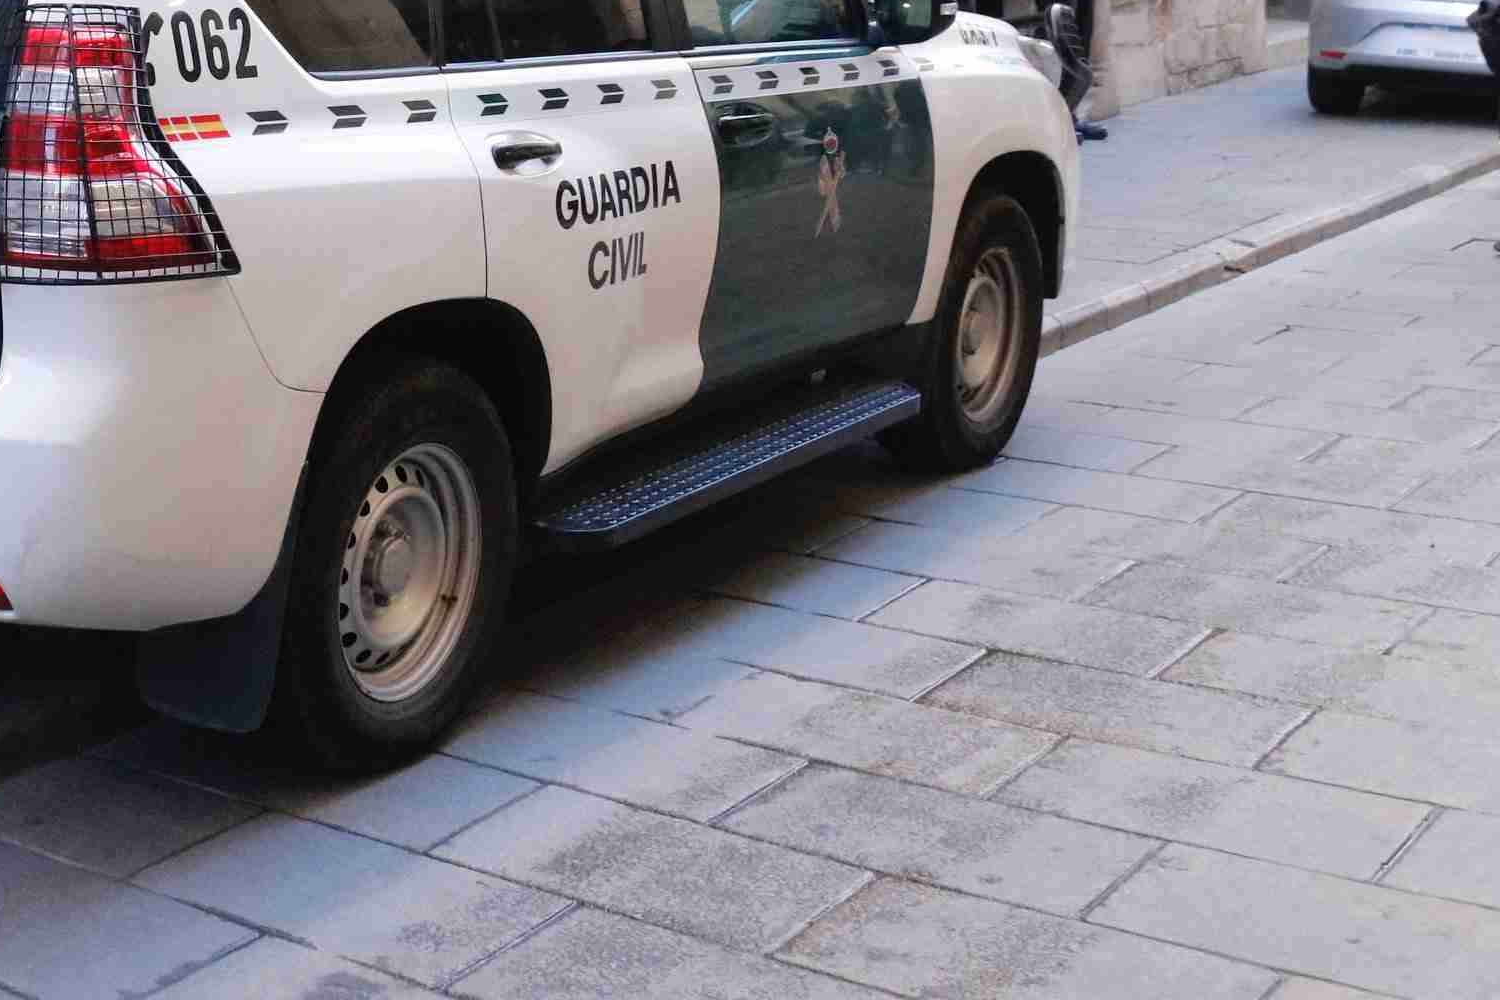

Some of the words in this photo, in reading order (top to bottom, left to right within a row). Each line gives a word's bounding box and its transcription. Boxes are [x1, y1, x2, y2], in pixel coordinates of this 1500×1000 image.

[170, 7, 258, 83] 062
[555, 160, 681, 230] GUARDIA
[588, 232, 648, 290] CIVIL
